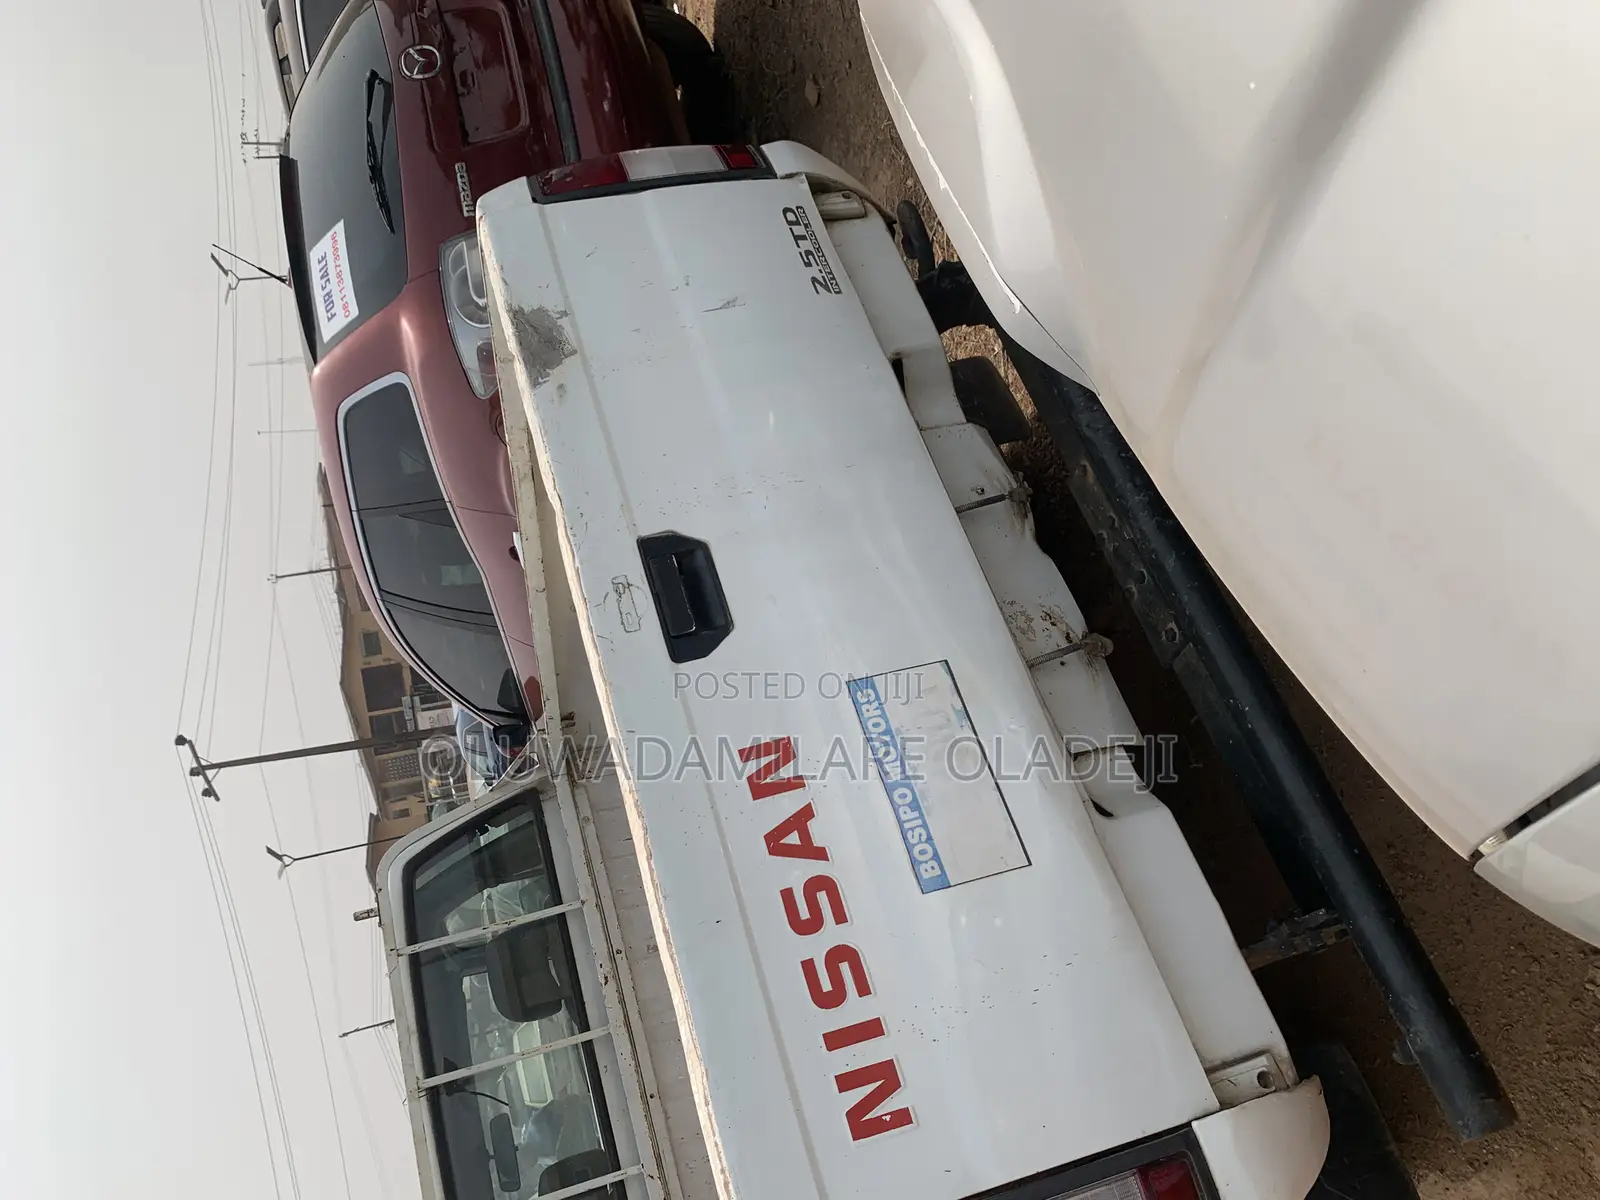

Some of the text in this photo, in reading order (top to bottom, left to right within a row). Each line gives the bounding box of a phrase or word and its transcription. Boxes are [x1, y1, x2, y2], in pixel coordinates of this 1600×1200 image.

[317, 252, 337, 322] FOR SALE
[782, 206, 833, 295] 2.5TD
[795, 205, 843, 295] INTERCOOLER
[893, 786, 942, 879] BOSIPO
[738, 736, 915, 1142] NISSAN
